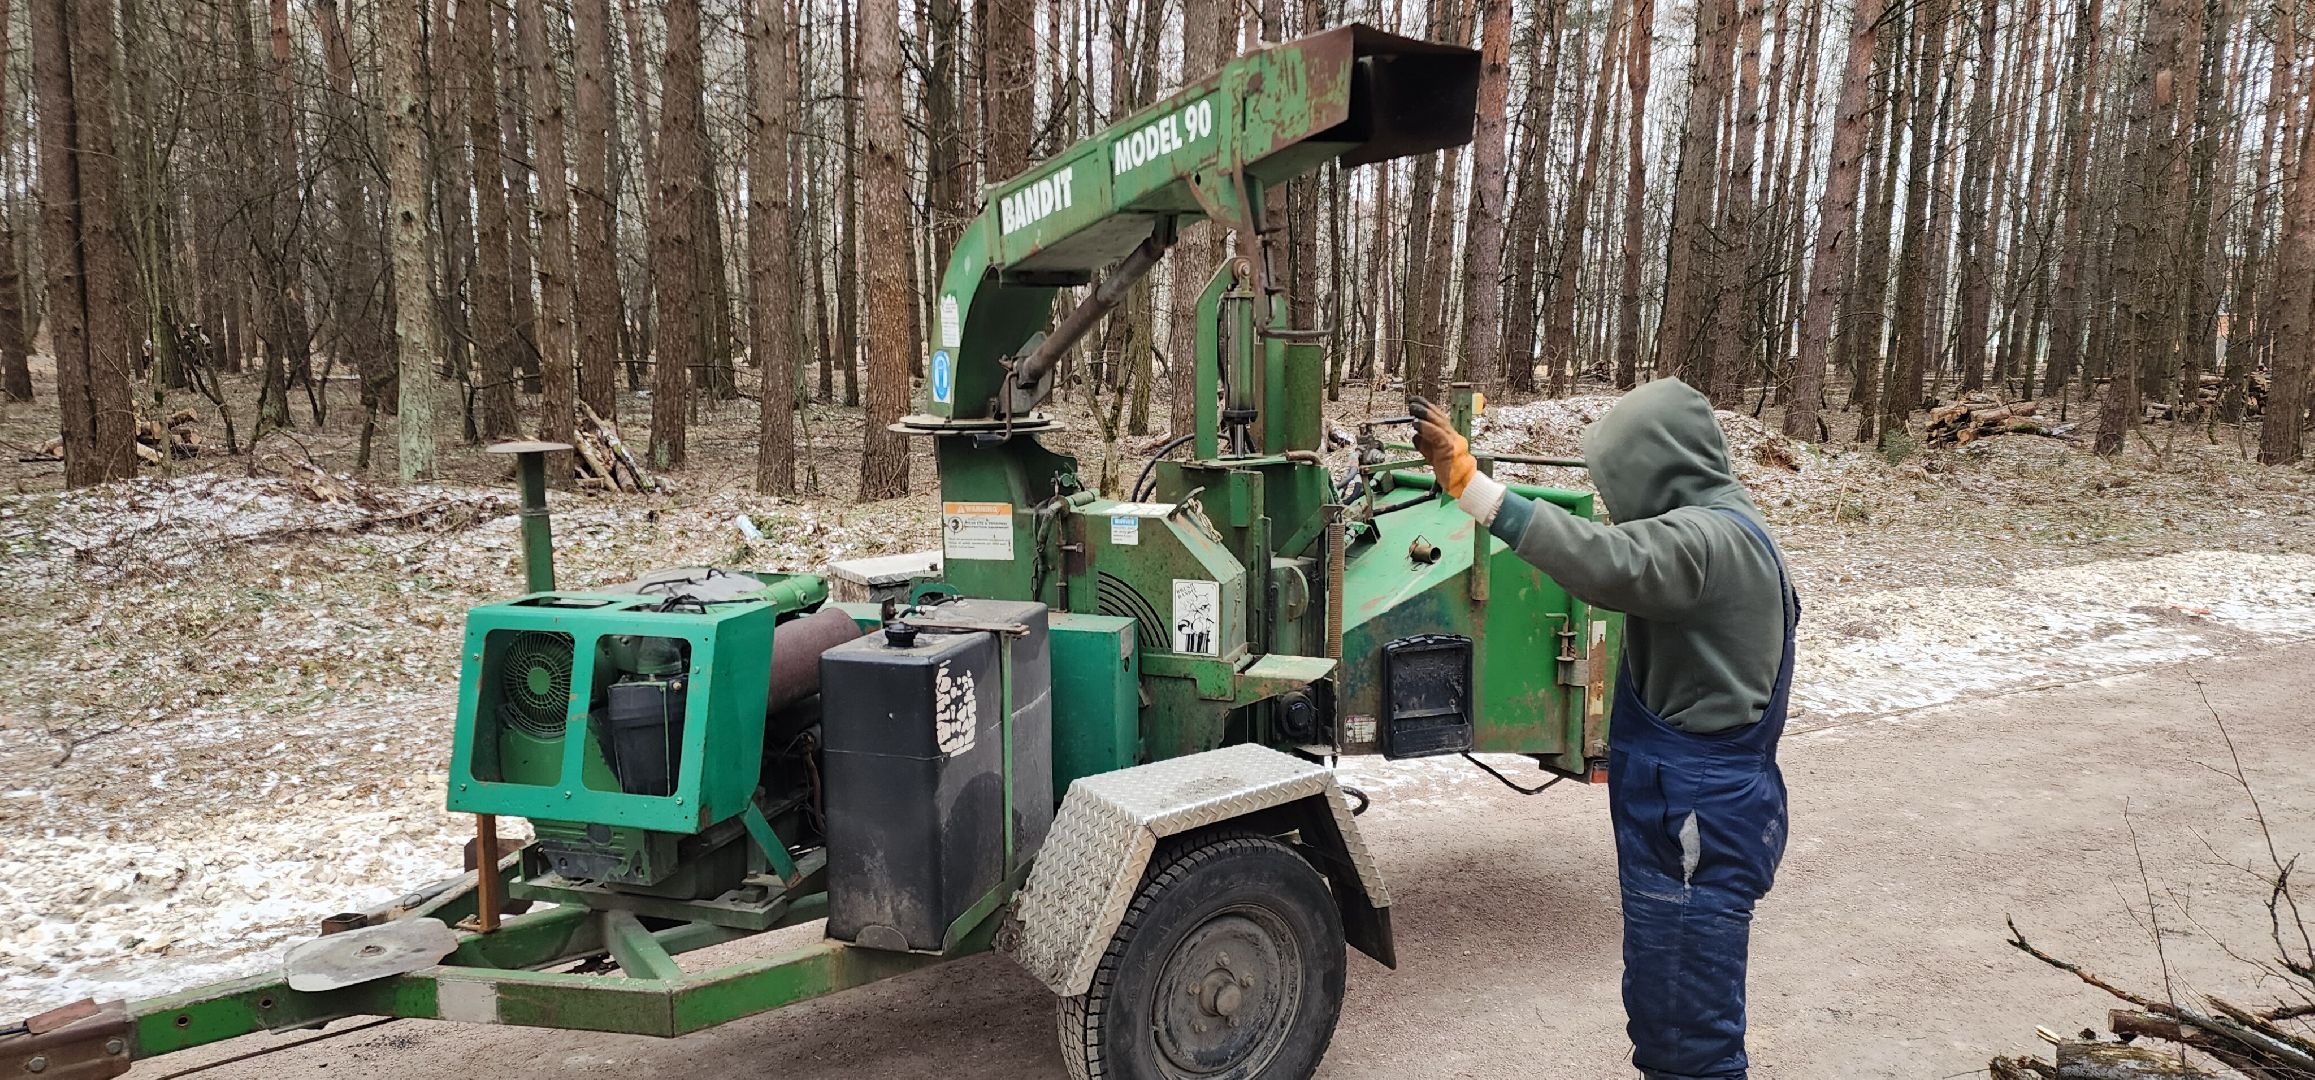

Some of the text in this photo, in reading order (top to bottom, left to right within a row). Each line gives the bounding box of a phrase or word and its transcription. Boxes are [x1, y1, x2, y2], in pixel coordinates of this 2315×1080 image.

[1001, 100, 1212, 236] BANDIT MODEL 90
